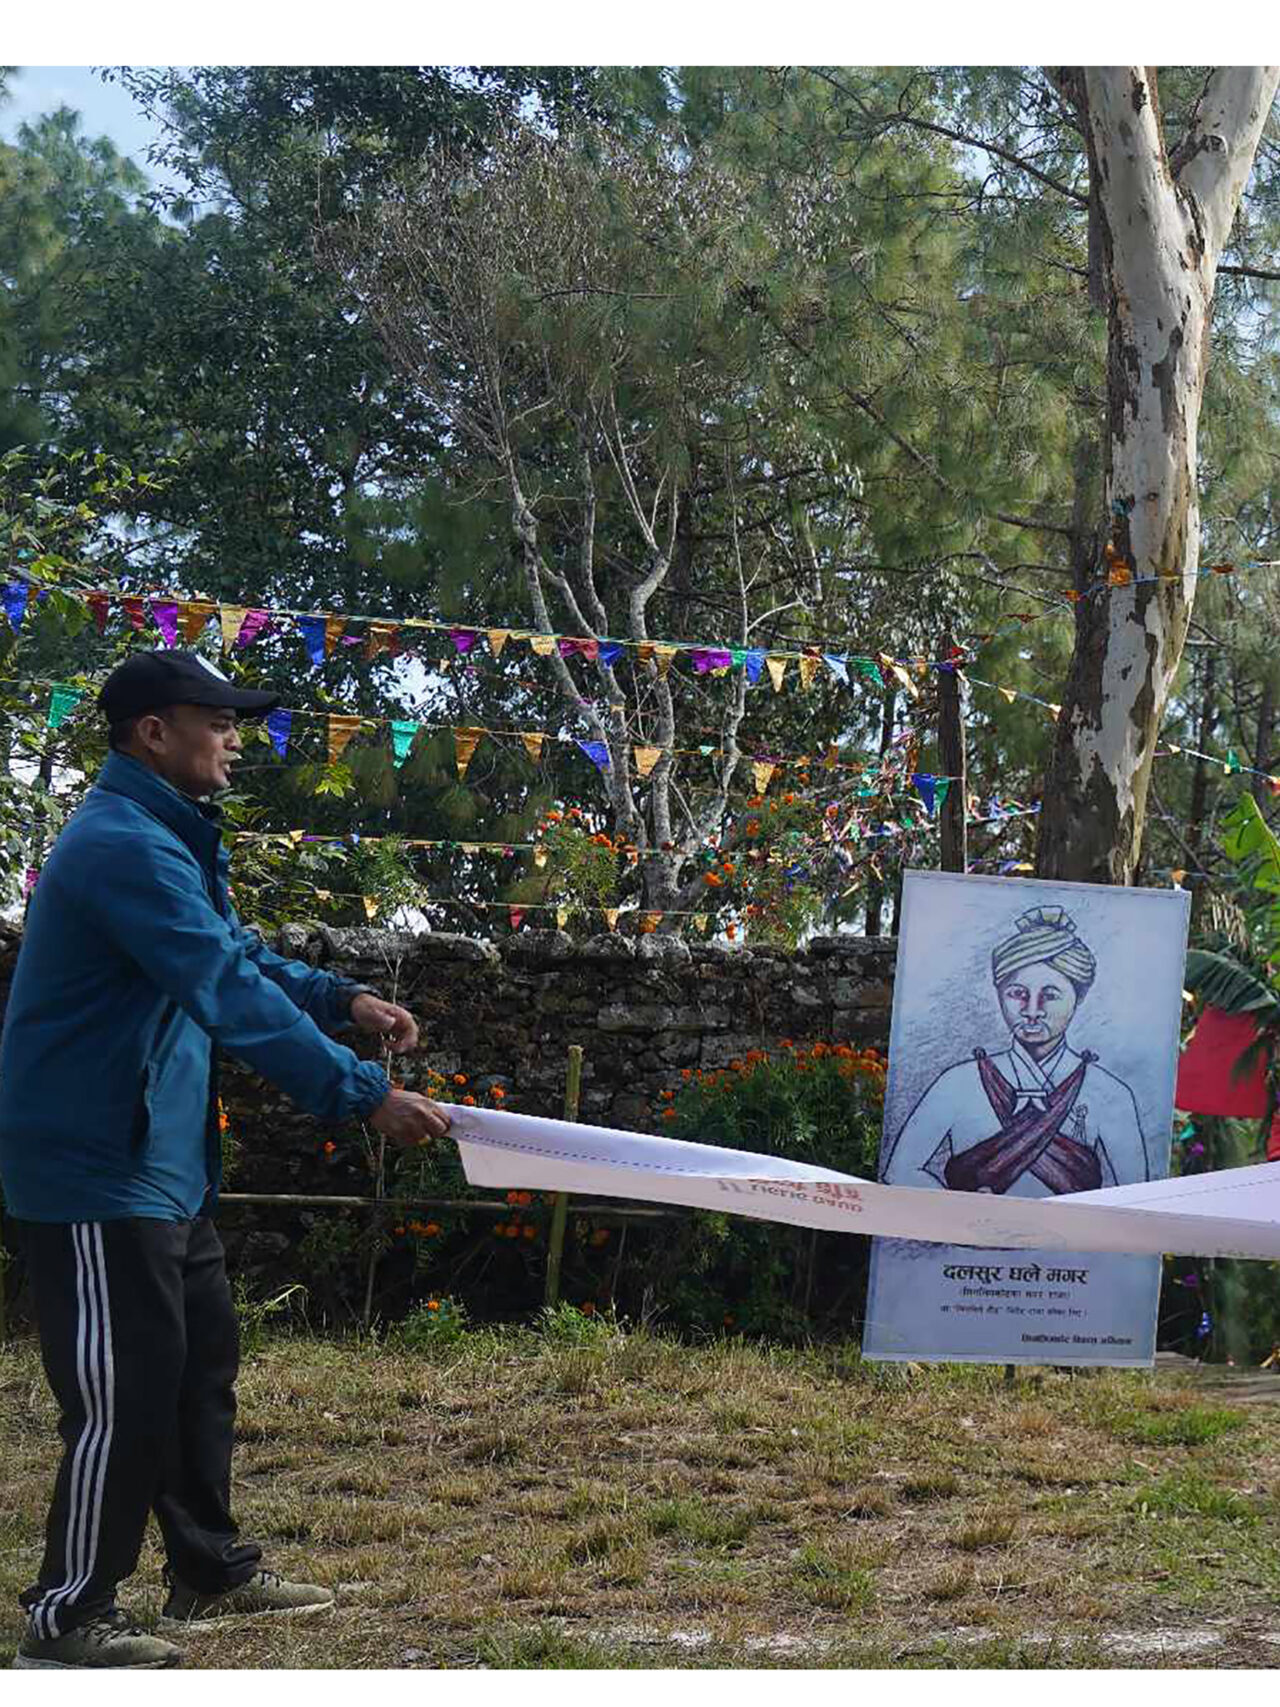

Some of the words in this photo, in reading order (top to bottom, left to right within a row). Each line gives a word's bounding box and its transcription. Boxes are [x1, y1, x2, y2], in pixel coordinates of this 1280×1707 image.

[943, 1264, 1004, 1284] दलसुर
[1008, 1263, 1042, 1283] घले
[1046, 1267, 1090, 1285] मगर
